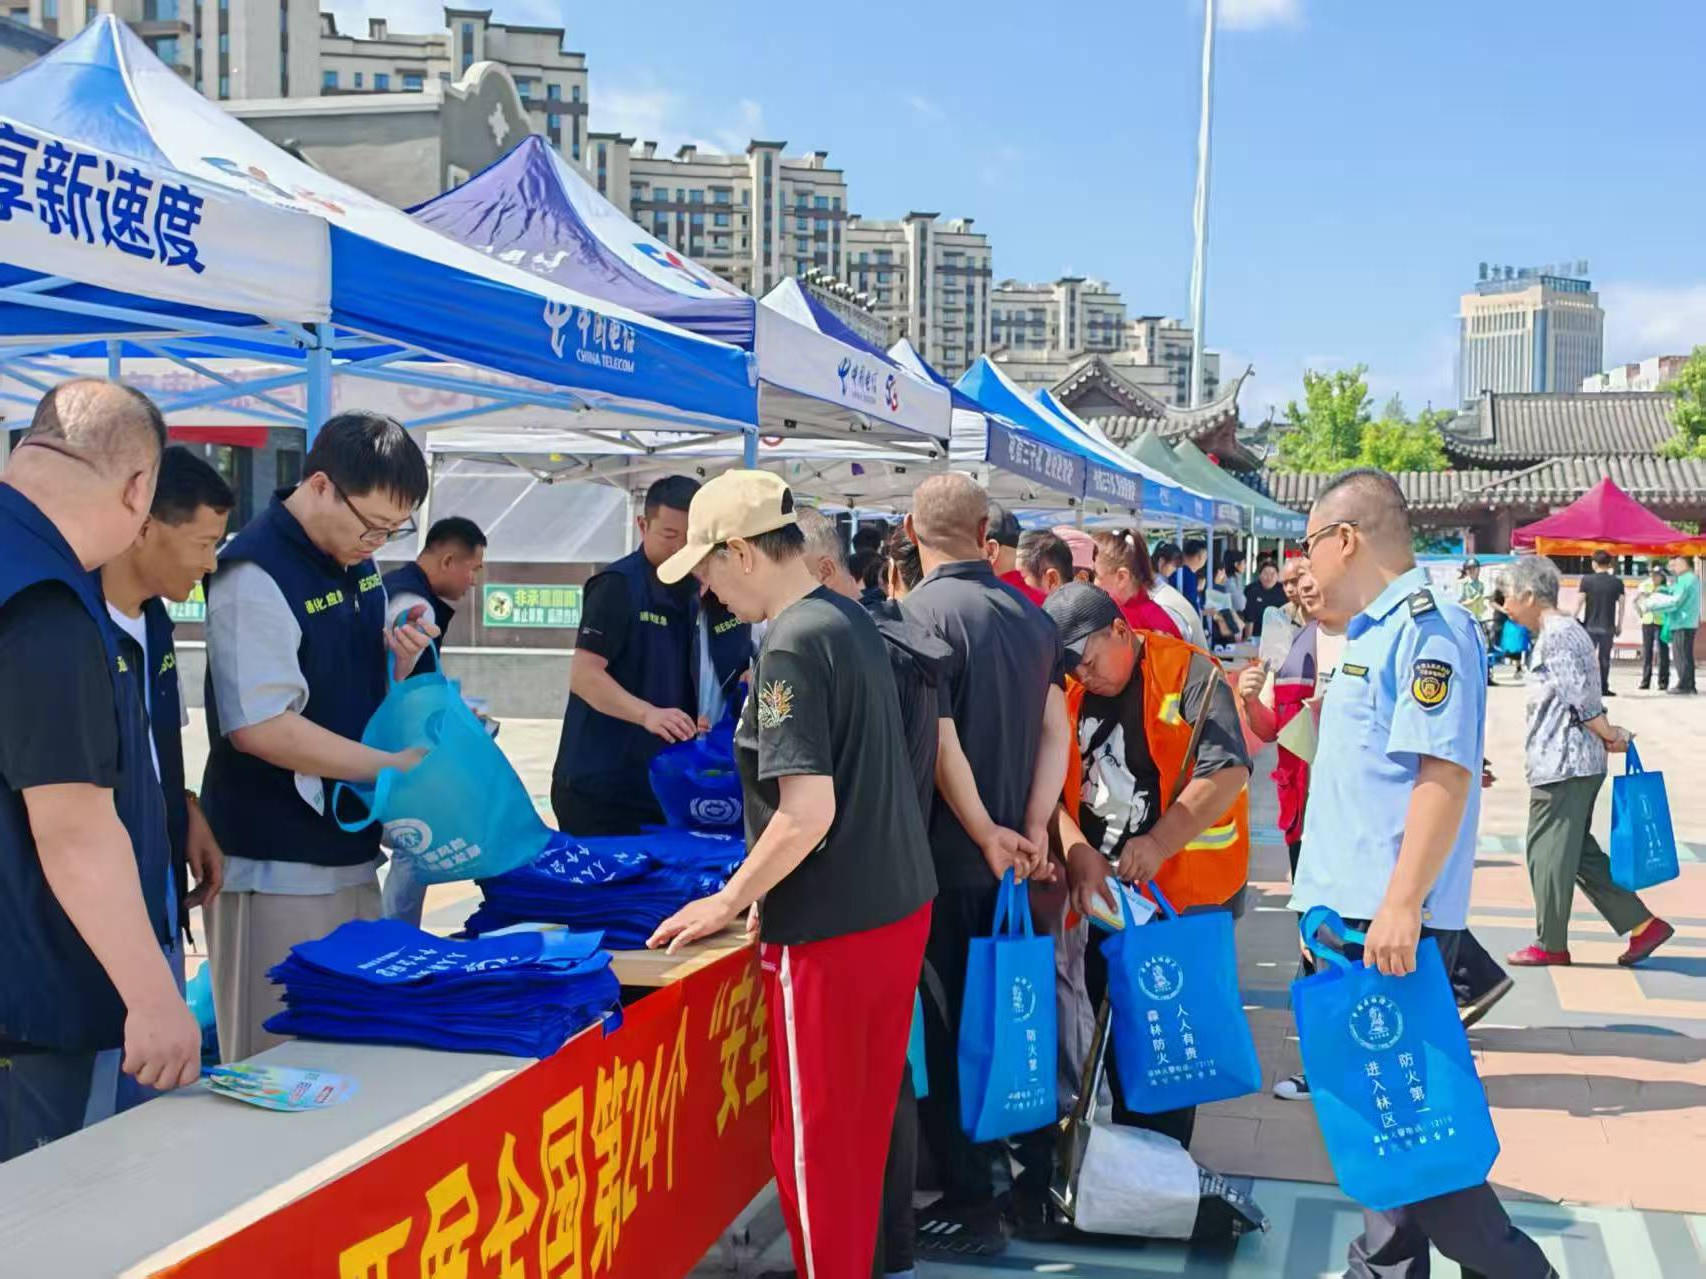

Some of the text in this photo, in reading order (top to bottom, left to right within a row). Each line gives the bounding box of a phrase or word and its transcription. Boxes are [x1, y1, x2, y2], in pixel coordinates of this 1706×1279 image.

[0, 121, 206, 275] 享新速度
[576, 348, 635, 374] CHINA TELECOM
[1176, 1003, 1198, 1062] 人人有责
[1363, 1060, 1399, 1129] 进入林区
[1398, 1051, 1432, 1114] 防火第一
